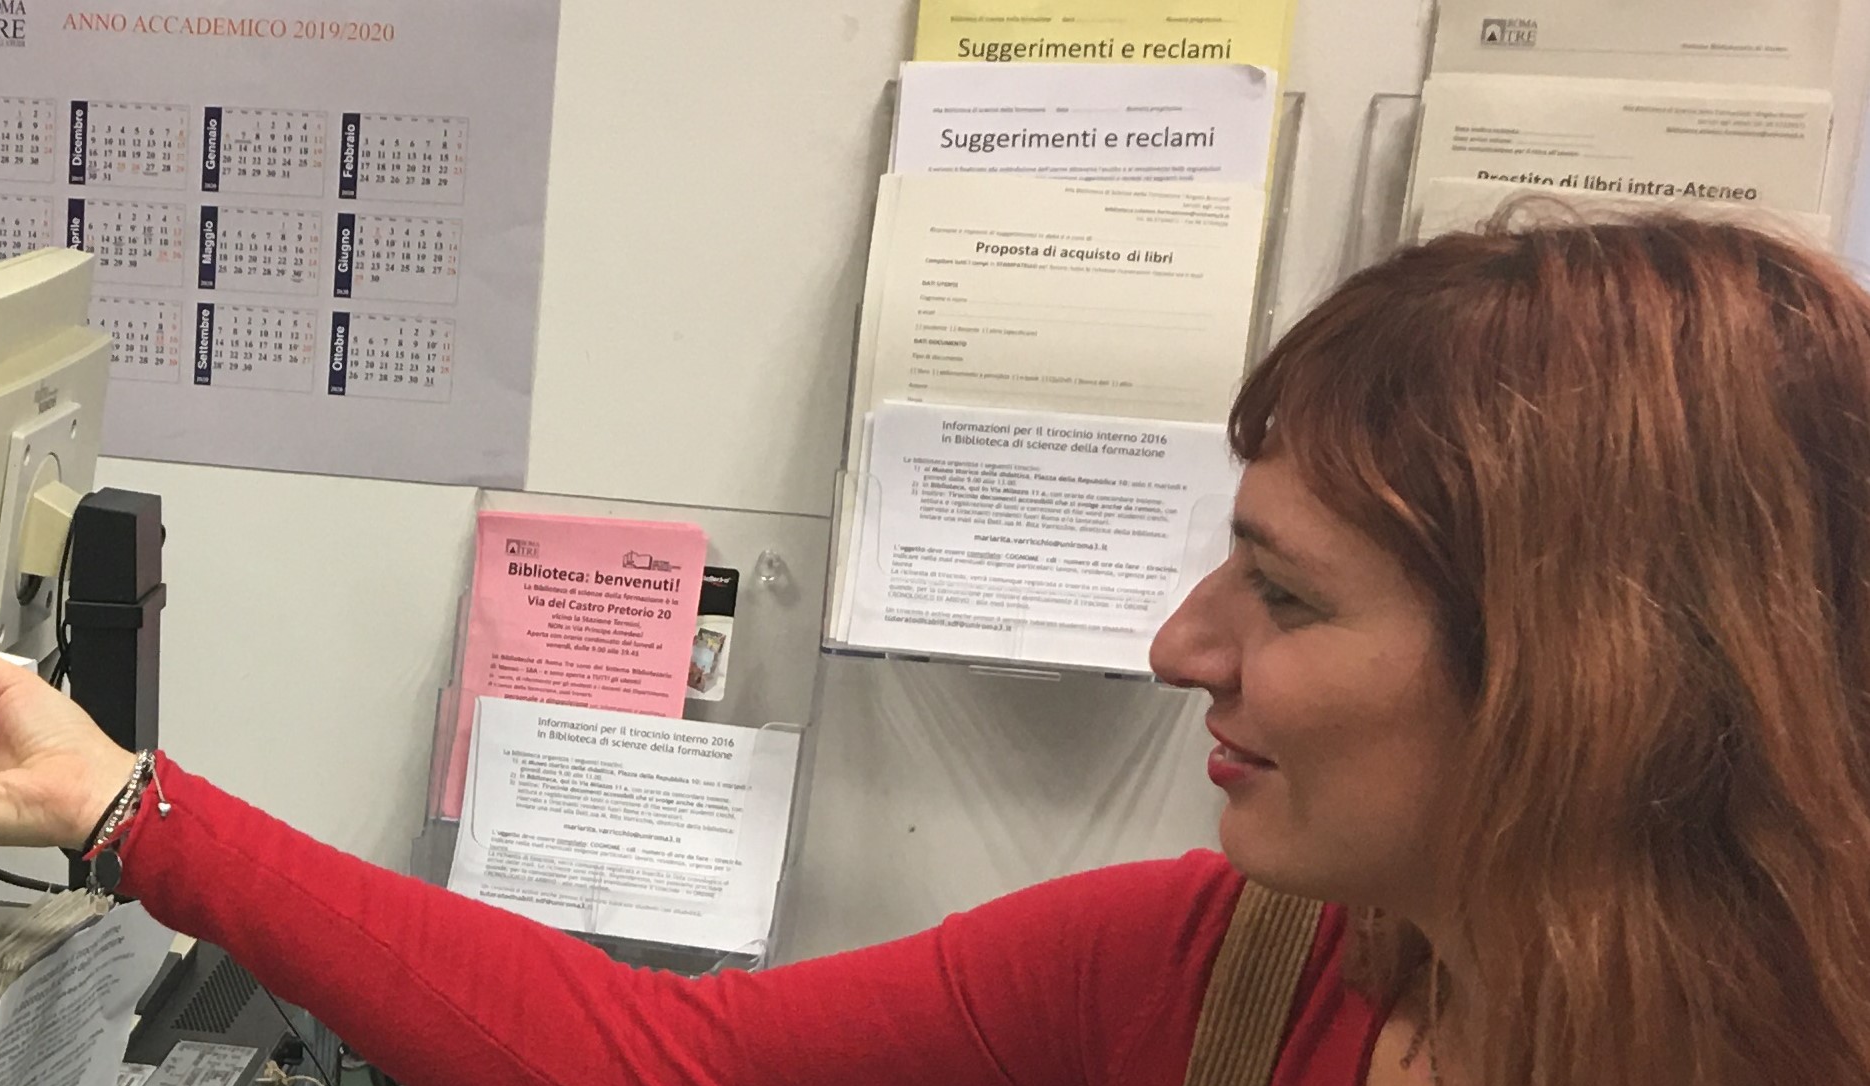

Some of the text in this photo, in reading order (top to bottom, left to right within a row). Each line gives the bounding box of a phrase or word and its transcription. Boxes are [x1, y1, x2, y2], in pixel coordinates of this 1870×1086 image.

[62, 12, 396, 43] ANNO ACCADEMICO 2019/2020
[1506, 31, 1537, 44] TRE
[957, 37, 1232, 63] Suggerimenti e reclami
[71, 108, 84, 167] Dicembre
[206, 118, 218, 170] Gennaio
[342, 123, 356, 178] Febbraio
[940, 126, 1216, 153] Suggerimenti e reclami
[1559, 174, 1579, 189] di
[1583, 175, 1622, 193] libri
[1628, 178, 1758, 201] intra-Ateneo
[202, 220, 215, 265] Maggio
[338, 228, 351, 274] Giugno
[975, 241, 1174, 265] Proposta di acquisto di libri
[197, 308, 210, 370] Settembre
[332, 325, 346, 371] Ottobre
[941, 434, 1166, 459] in Biblioteca di scienze della formazione
[942, 421, 1168, 445] Informazioni per il tirocinio interno 2016
[507, 562, 681, 593] Biblioteca: benvenuti!
[528, 595, 546, 607] Via
[568, 600, 605, 614] Castro
[608, 605, 655, 619] Pretorio
[657, 609, 672, 620] 20
[537, 730, 734, 760] in Biblioteca di scienze della formazione
[538, 717, 735, 748] Informazioni per il tirocinio interno 2016
